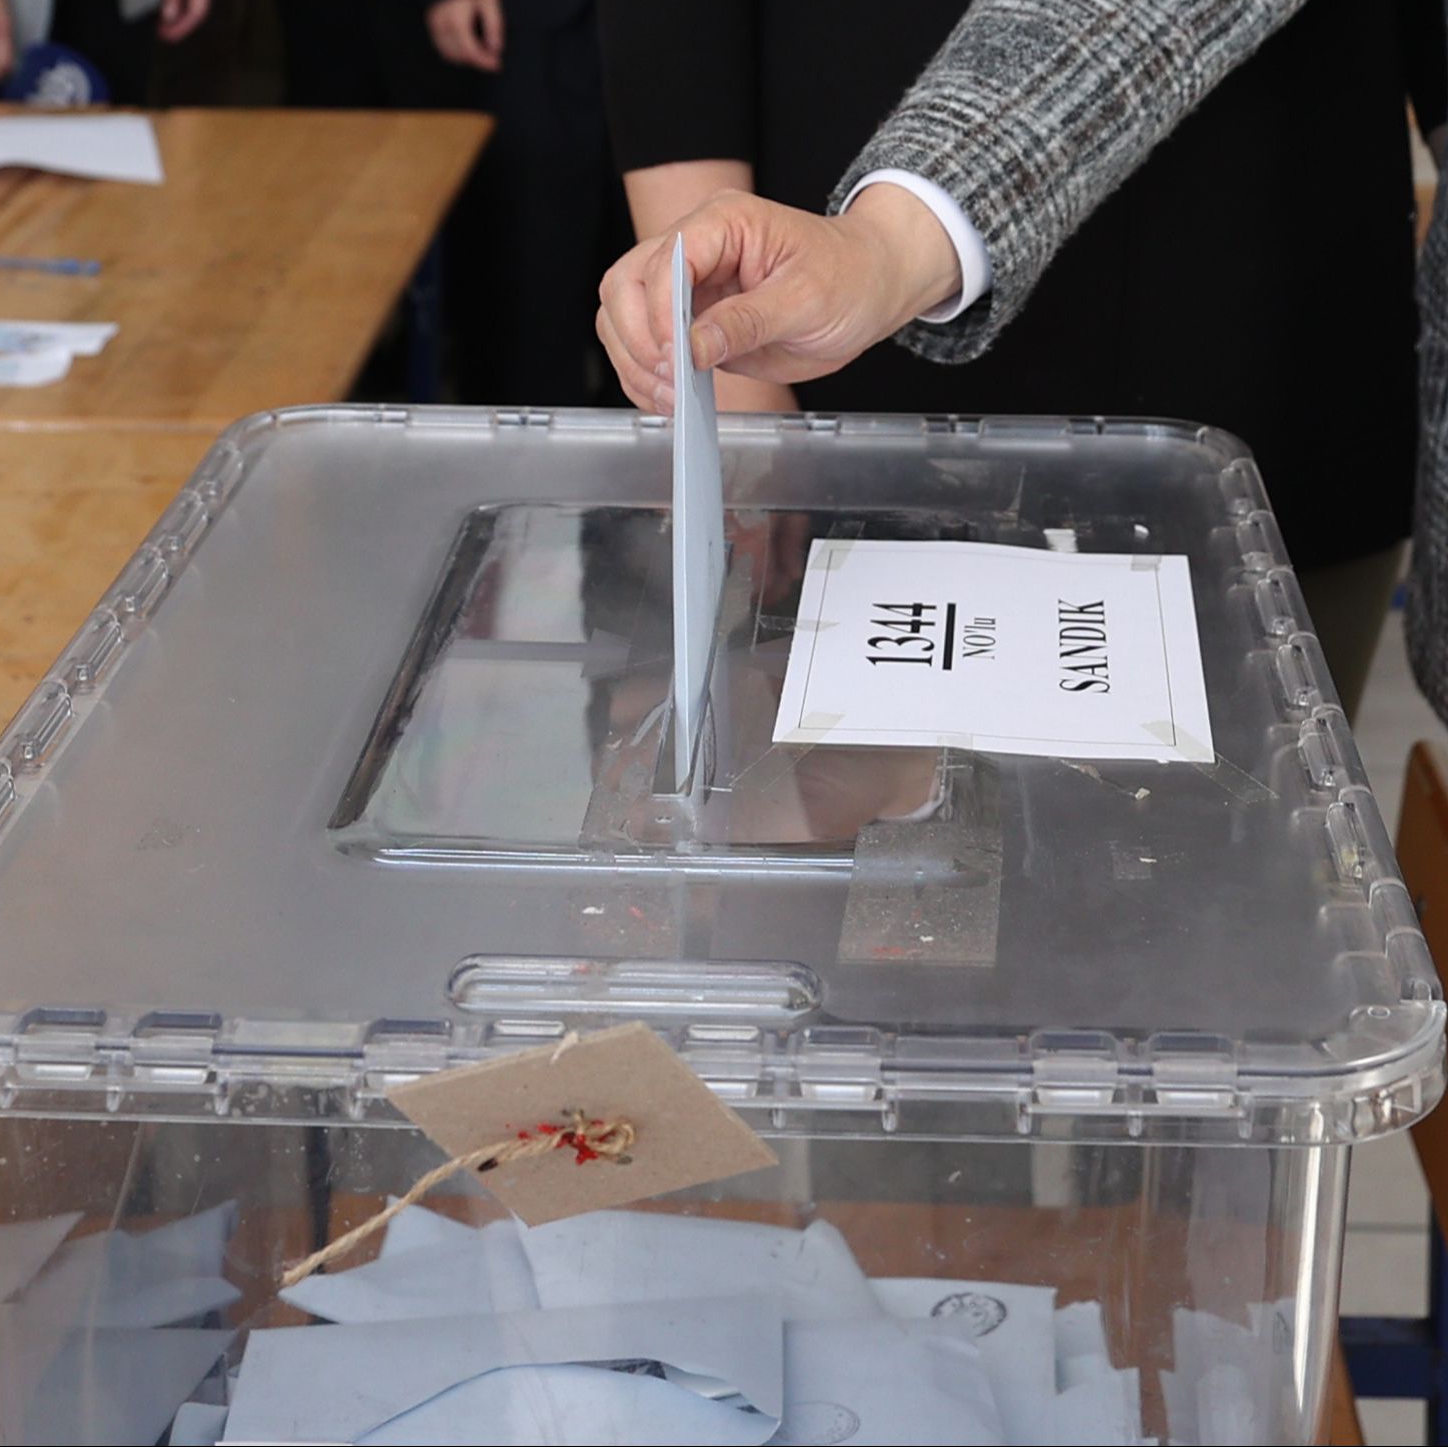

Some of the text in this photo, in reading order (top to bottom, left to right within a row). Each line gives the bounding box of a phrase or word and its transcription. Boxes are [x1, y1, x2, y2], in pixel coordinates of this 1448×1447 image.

[865, 602, 937, 668] 1344
[962, 617, 996, 660] NO'lu
[1058, 598, 1110, 694] SANDIK
